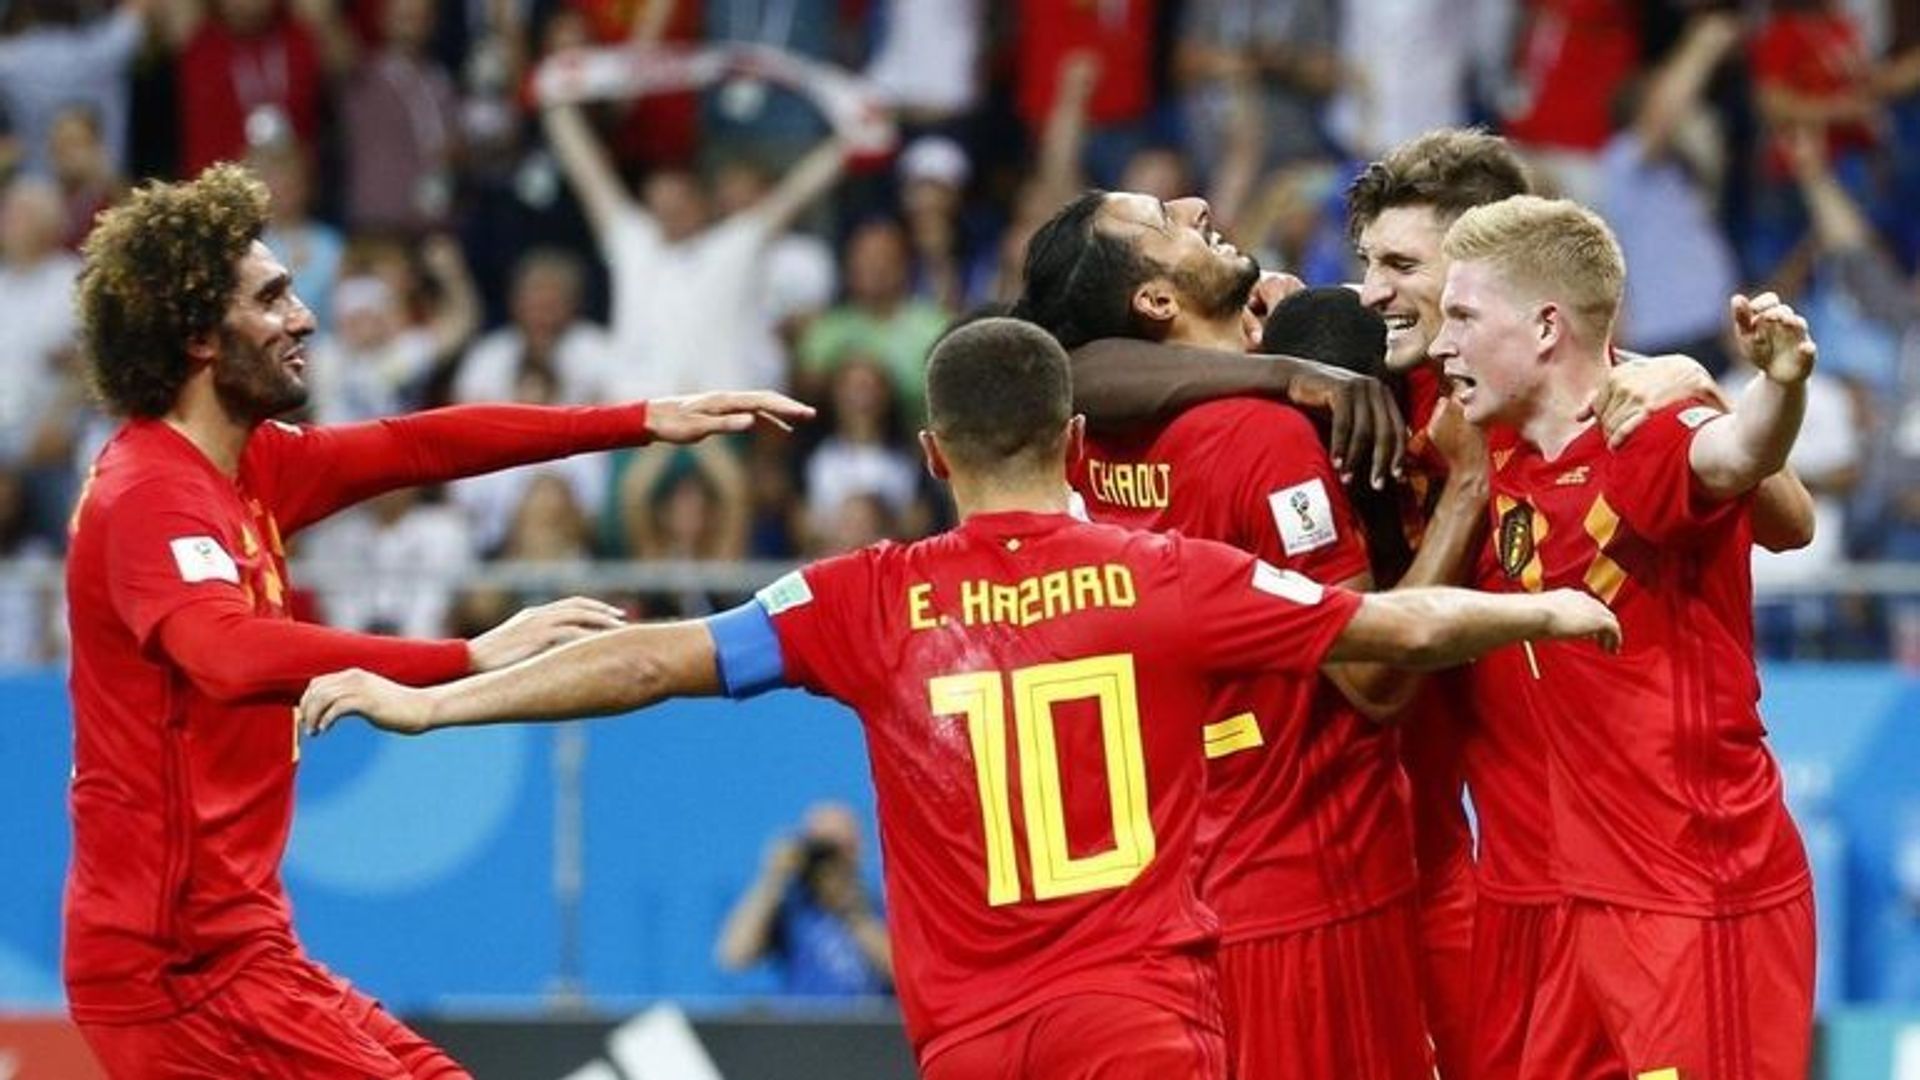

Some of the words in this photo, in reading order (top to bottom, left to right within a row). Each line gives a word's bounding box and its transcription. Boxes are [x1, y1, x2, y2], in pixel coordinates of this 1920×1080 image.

[908, 583, 949, 629] E.
[961, 563, 1136, 627] HAZARD
[929, 653, 1156, 906] 10
